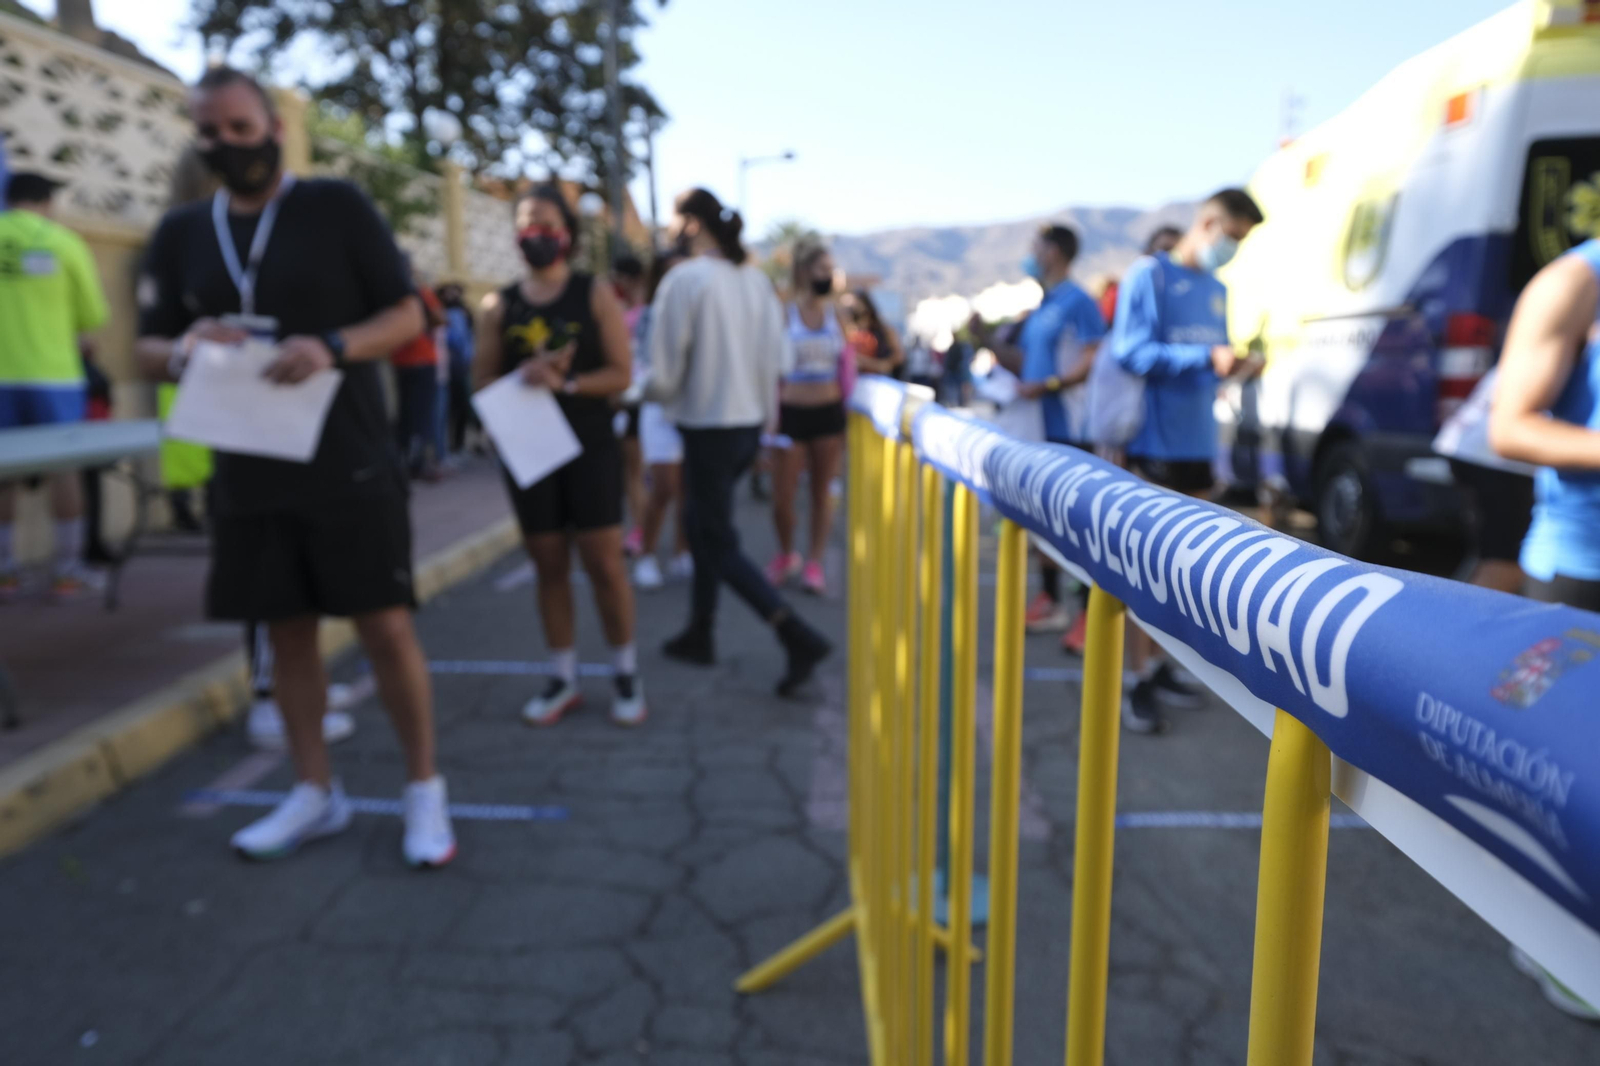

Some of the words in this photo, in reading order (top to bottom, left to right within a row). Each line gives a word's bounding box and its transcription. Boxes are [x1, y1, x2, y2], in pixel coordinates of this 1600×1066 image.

[1049, 463, 1112, 548] DE
[1085, 481, 1404, 719] SEGURIDAD
[1416, 691, 1576, 809] DIPUTACIÓN
